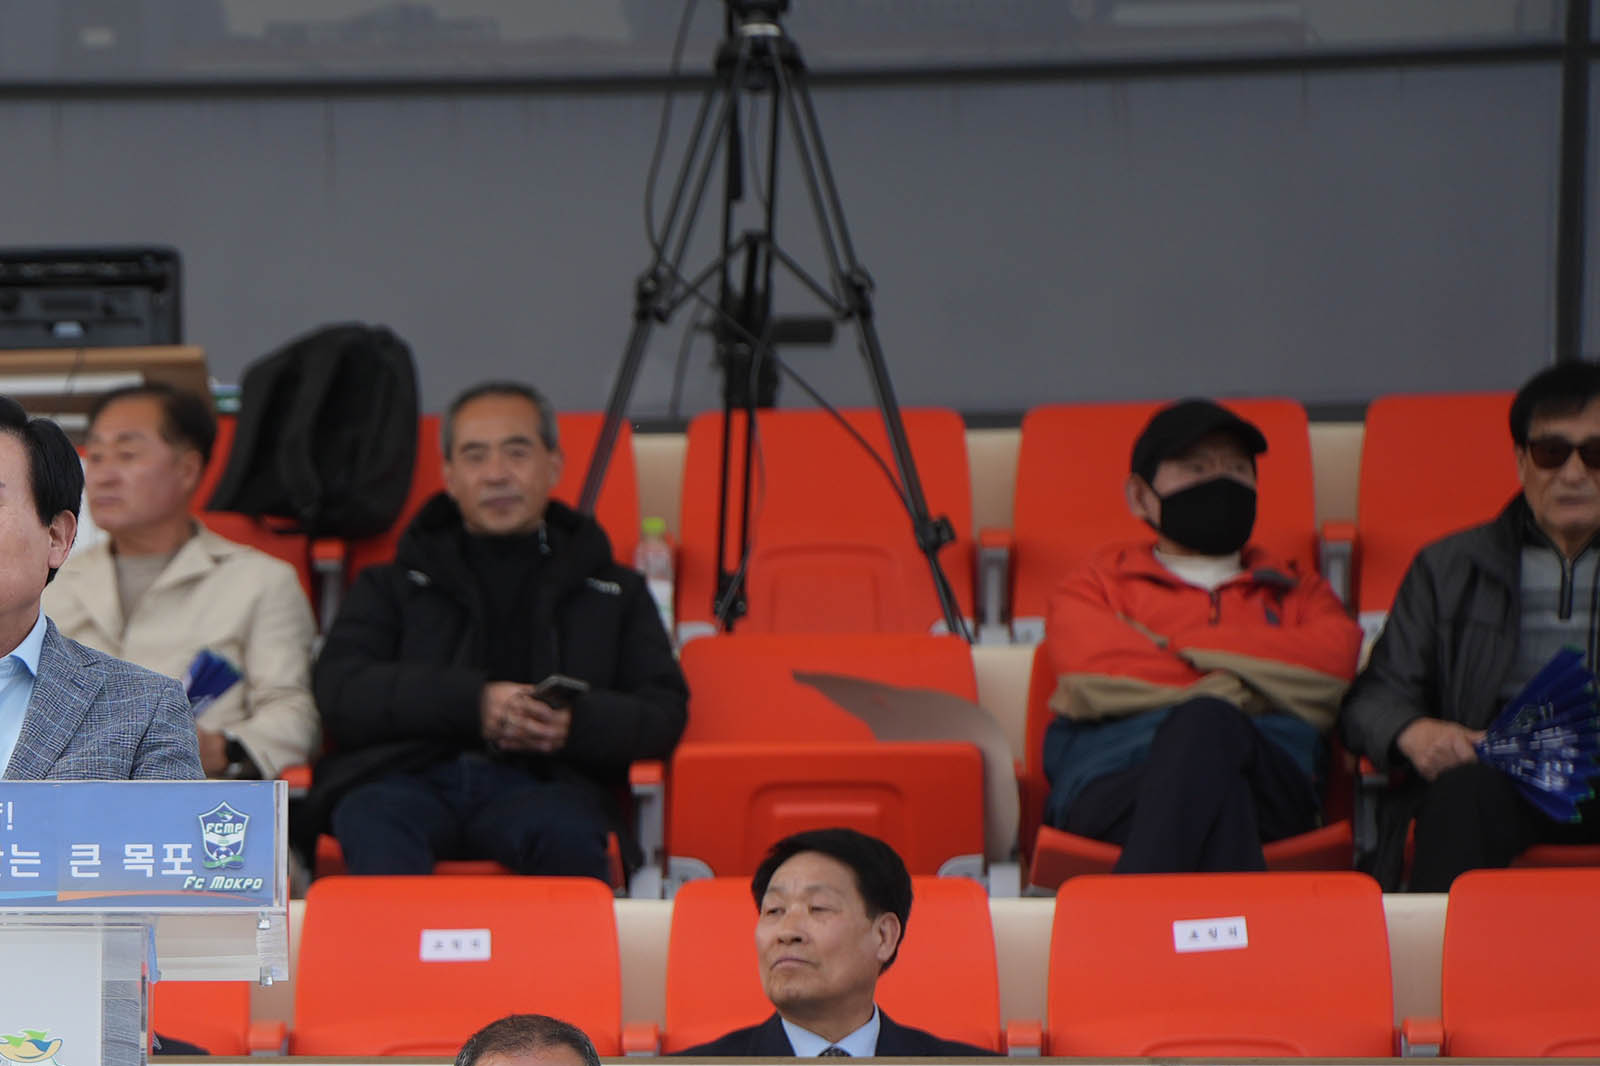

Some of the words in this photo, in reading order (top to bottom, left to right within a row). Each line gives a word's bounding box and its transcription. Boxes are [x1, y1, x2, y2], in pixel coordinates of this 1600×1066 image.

[205, 822, 245, 834] FCMP
[69, 843, 102, 878] 큰
[123, 843, 194, 878] 목포
